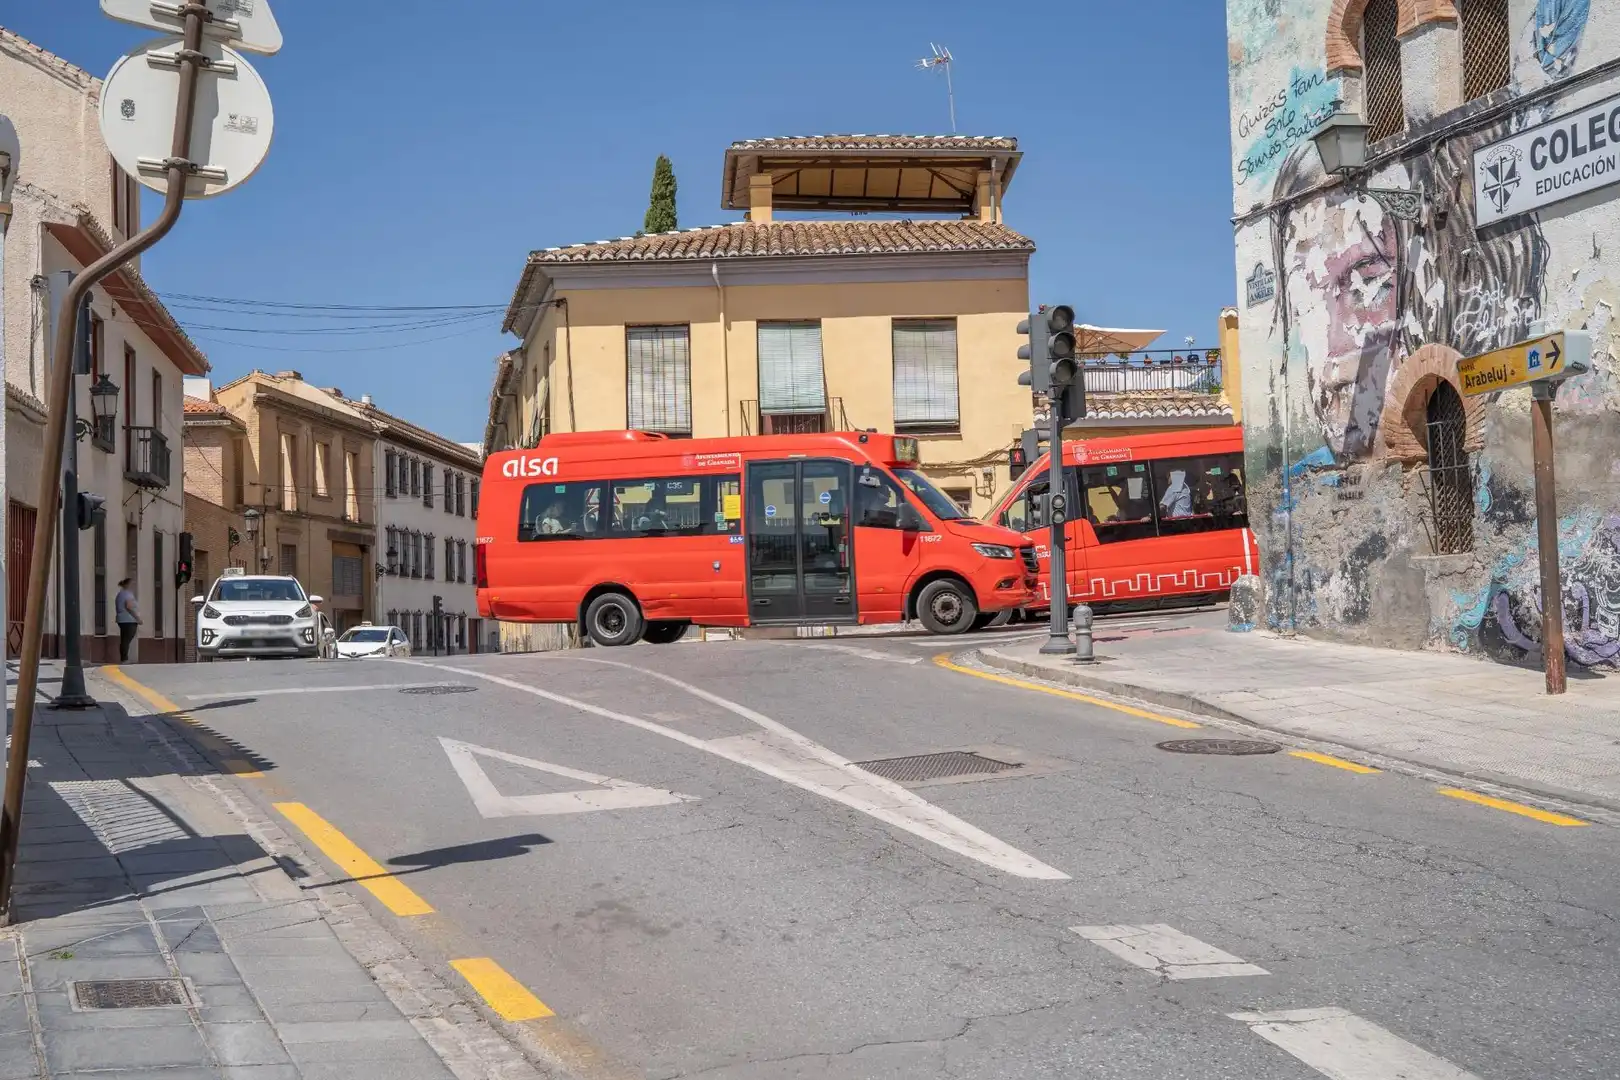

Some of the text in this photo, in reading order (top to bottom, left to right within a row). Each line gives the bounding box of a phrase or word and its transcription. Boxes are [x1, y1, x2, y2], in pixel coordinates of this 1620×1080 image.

[1536, 154, 1616, 196] EDUCACIÓN
[1465, 364, 1508, 388] Arabeluj
[502, 455, 559, 478] alsa
